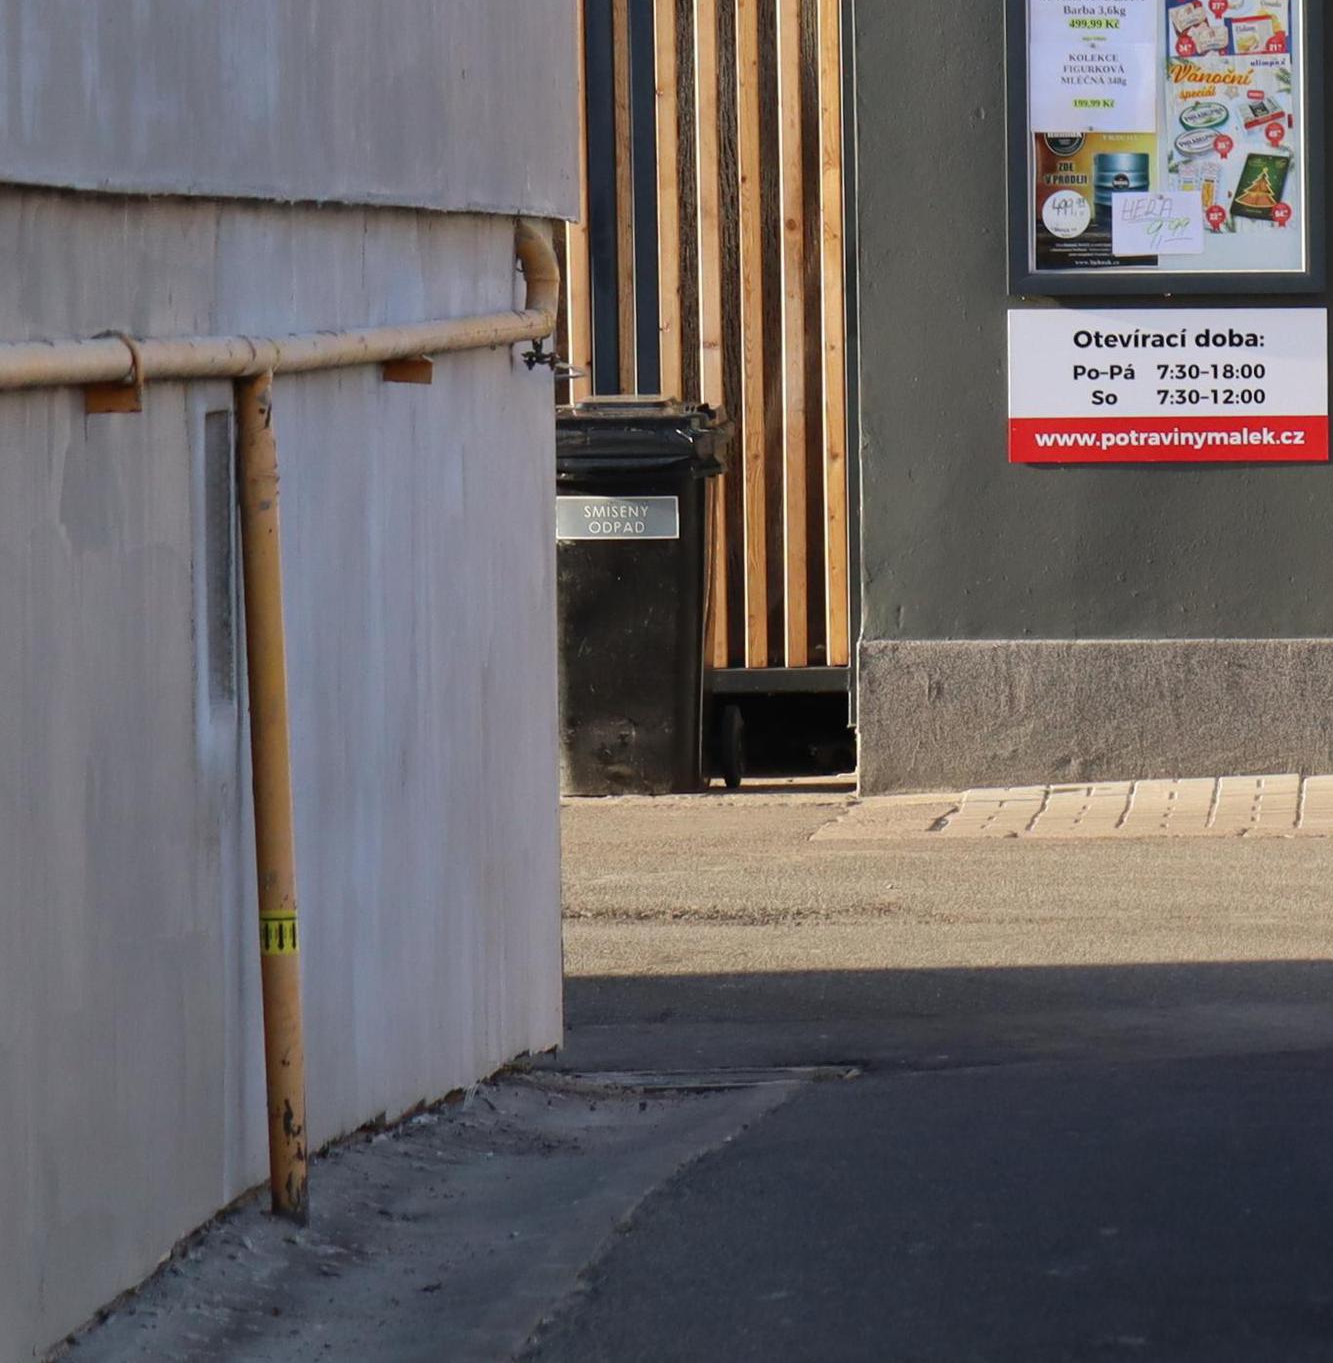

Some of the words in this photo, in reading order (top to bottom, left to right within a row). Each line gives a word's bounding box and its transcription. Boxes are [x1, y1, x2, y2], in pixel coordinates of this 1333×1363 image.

[1063, 5, 1095, 15] Barba
[1073, 328, 1187, 348] Otevírací
[1195, 328, 1265, 348] doba:
[1073, 364, 1136, 380] Po-Pá
[1157, 363, 1266, 380] 7:30-18:00
[1091, 390, 1118, 405] So
[1157, 389, 1266, 405] 7:30-12:00
[1035, 427, 1305, 449] www.potravinymalek.cz
[584, 505, 649, 518] SMISENY
[588, 521, 645, 534] ODPAD
